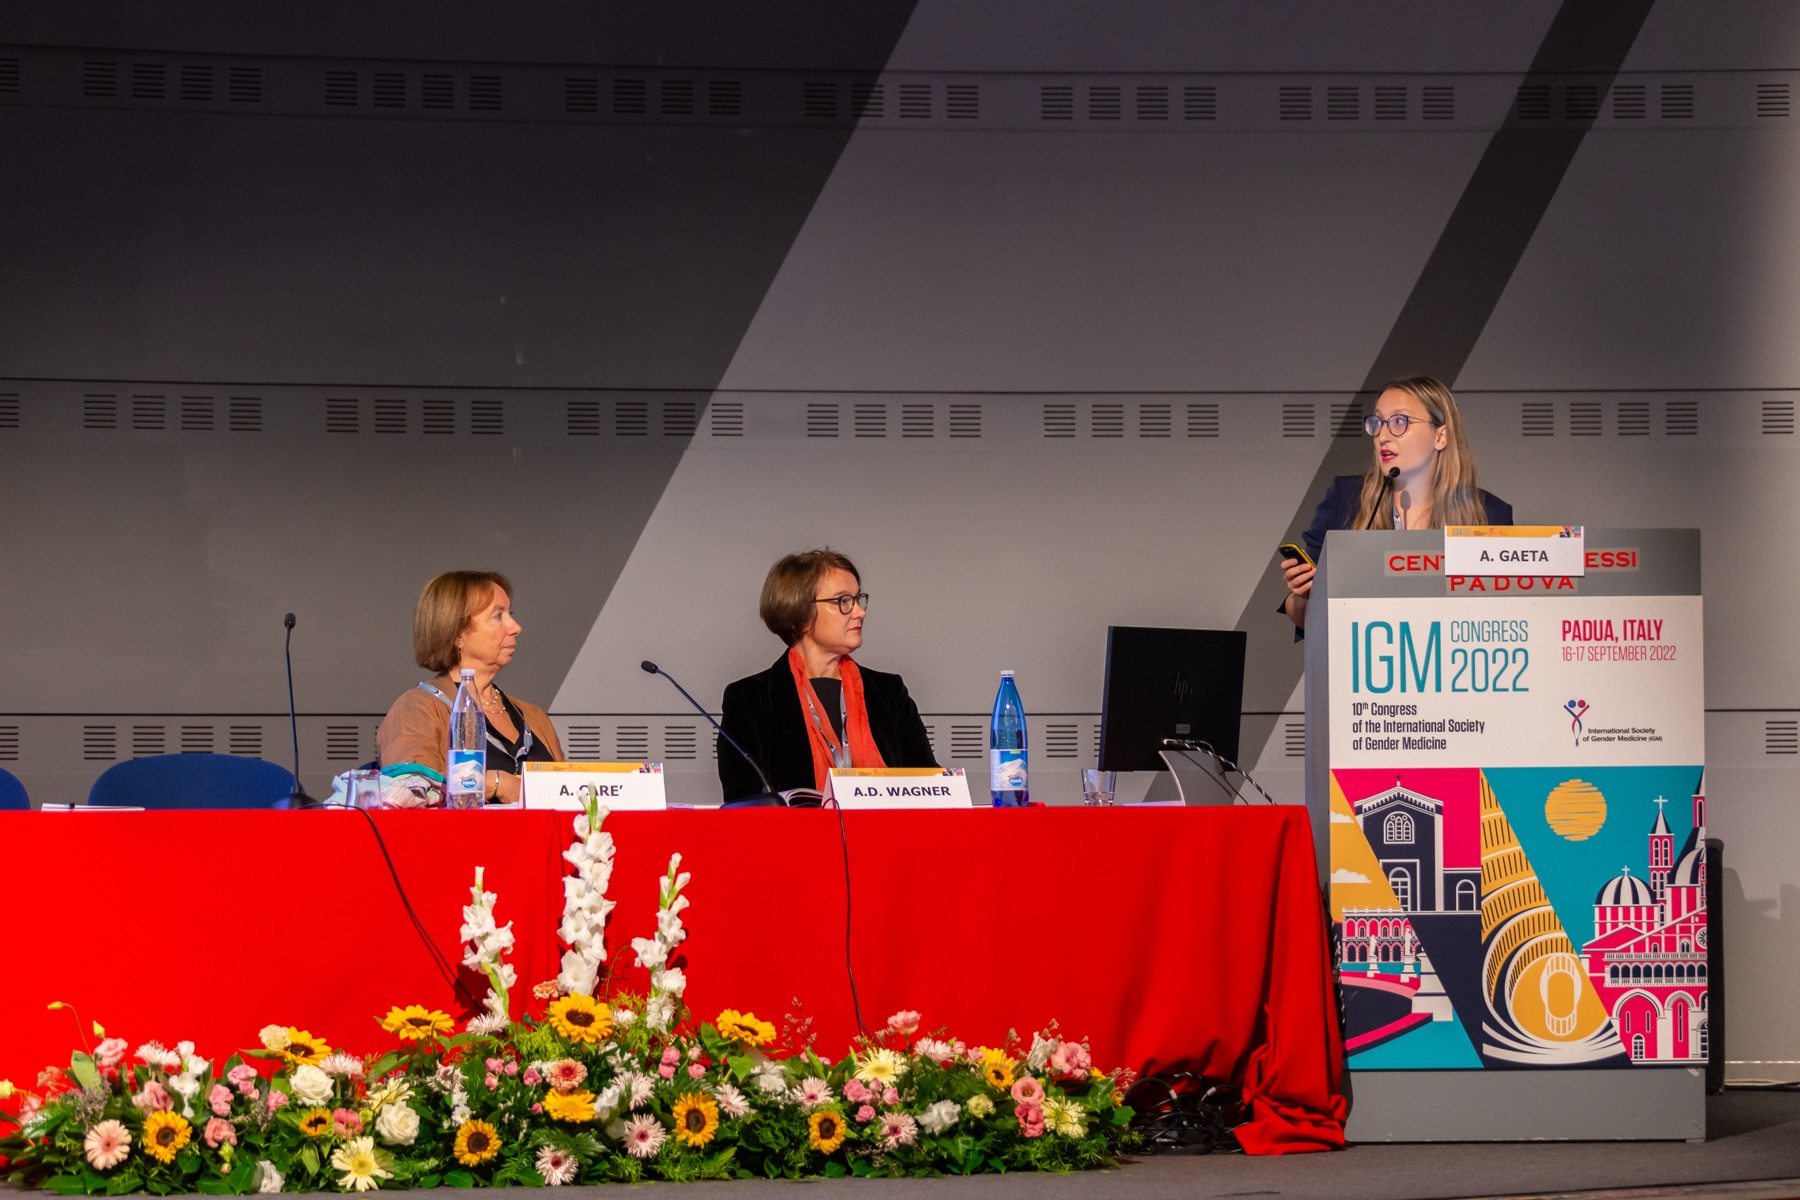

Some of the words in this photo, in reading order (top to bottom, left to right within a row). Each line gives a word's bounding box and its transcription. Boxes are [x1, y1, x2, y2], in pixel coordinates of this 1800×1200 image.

[1480, 551, 1494, 562] A.
[1499, 550, 1549, 562] GAETA
[1585, 551, 1636, 568] ESSI
[1450, 576, 1574, 591] PADOVA
[1450, 620, 1529, 643] CONGRESS
[1561, 619, 1619, 644] PADUA,
[1623, 619, 1663, 642] ITALY
[1351, 620, 1442, 694] IGM
[1561, 645, 1585, 662] 16-17
[1587, 645, 1647, 662] SEPTEMBER
[1649, 645, 1677, 661] 2022
[1450, 647, 1530, 693] 2022
[1352, 702, 1369, 716] 10th
[1371, 702, 1418, 717] Congress
[1352, 719, 1363, 733] of
[1364, 719, 1381, 733] the
[1383, 719, 1446, 733] International
[1448, 719, 1486, 734] Society
[1631, 727, 1655, 735] Society
[1352, 737, 1363, 751] of
[1365, 737, 1400, 751] Gender
[1402, 736, 1447, 750] Medicine
[559, 785, 574, 796] A.
[854, 786, 883, 797] A.D.
[886, 786, 951, 797] WAGNER
